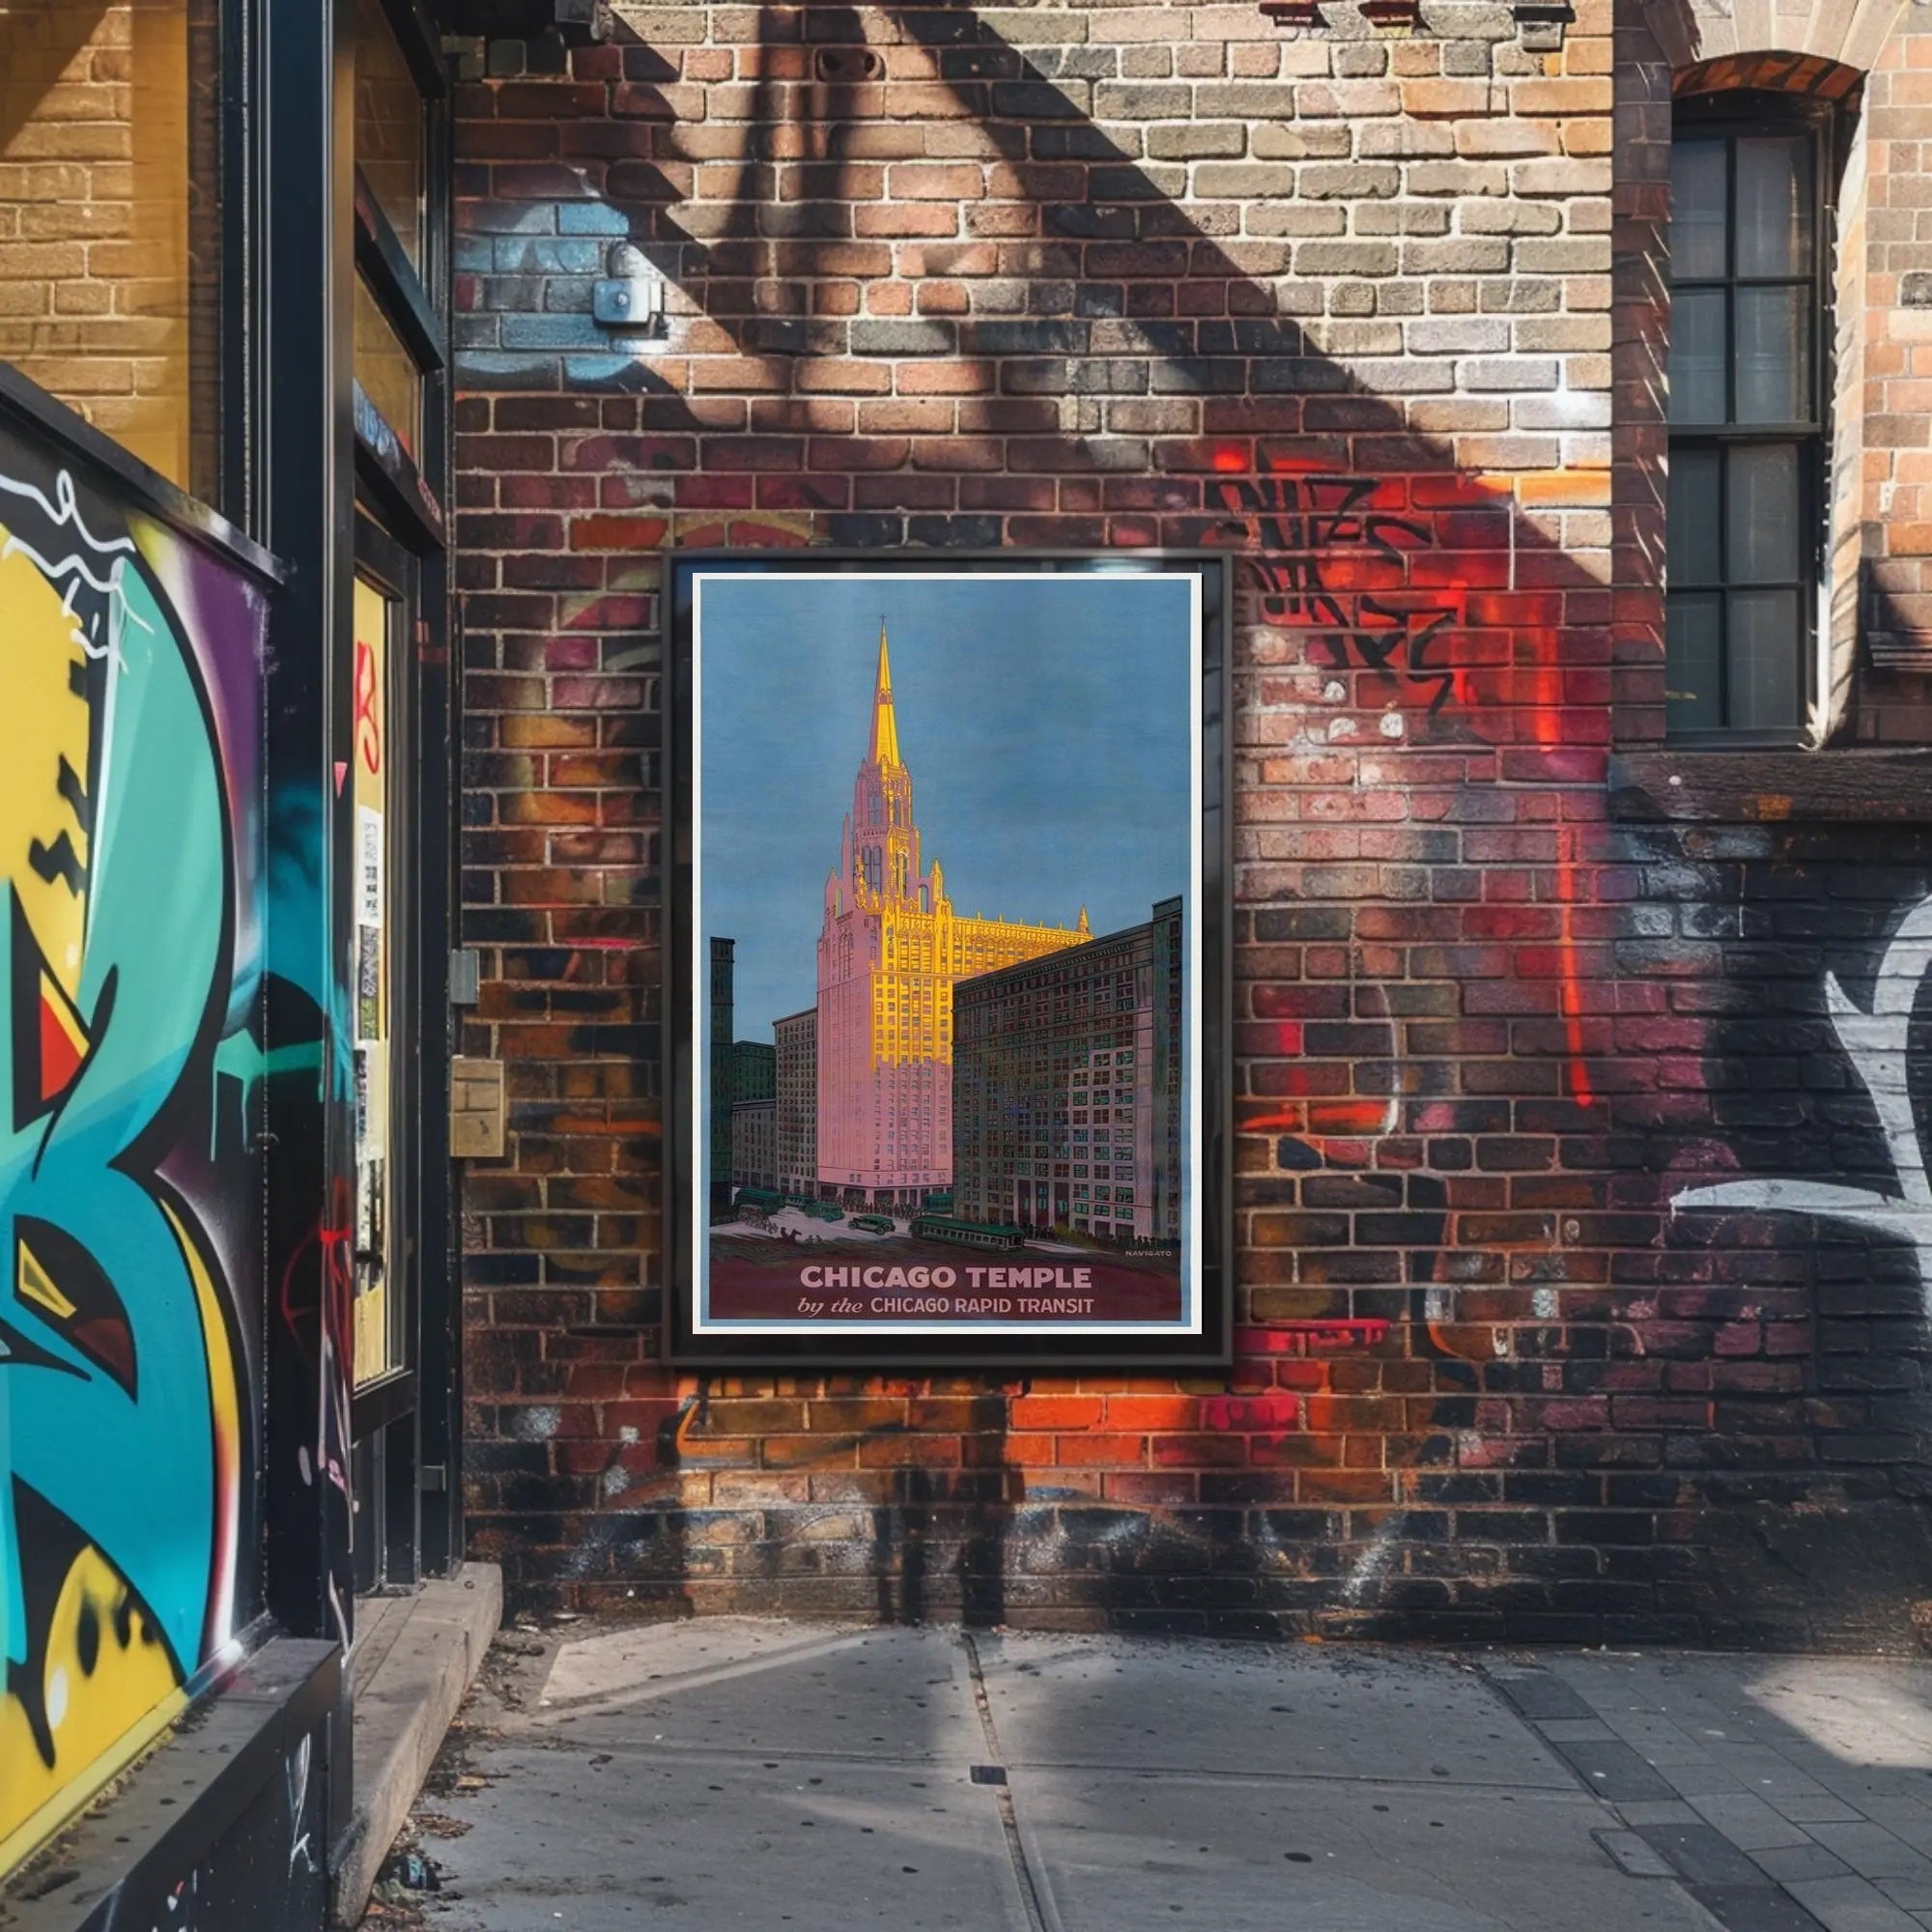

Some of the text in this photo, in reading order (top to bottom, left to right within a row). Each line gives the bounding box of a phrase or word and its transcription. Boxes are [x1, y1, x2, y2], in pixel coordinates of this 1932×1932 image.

[800, 1265, 1093, 1289] CHICAGO TEMPLE
[797, 1297, 1094, 1318] by the CHICAGO RAPID TRANSIT
